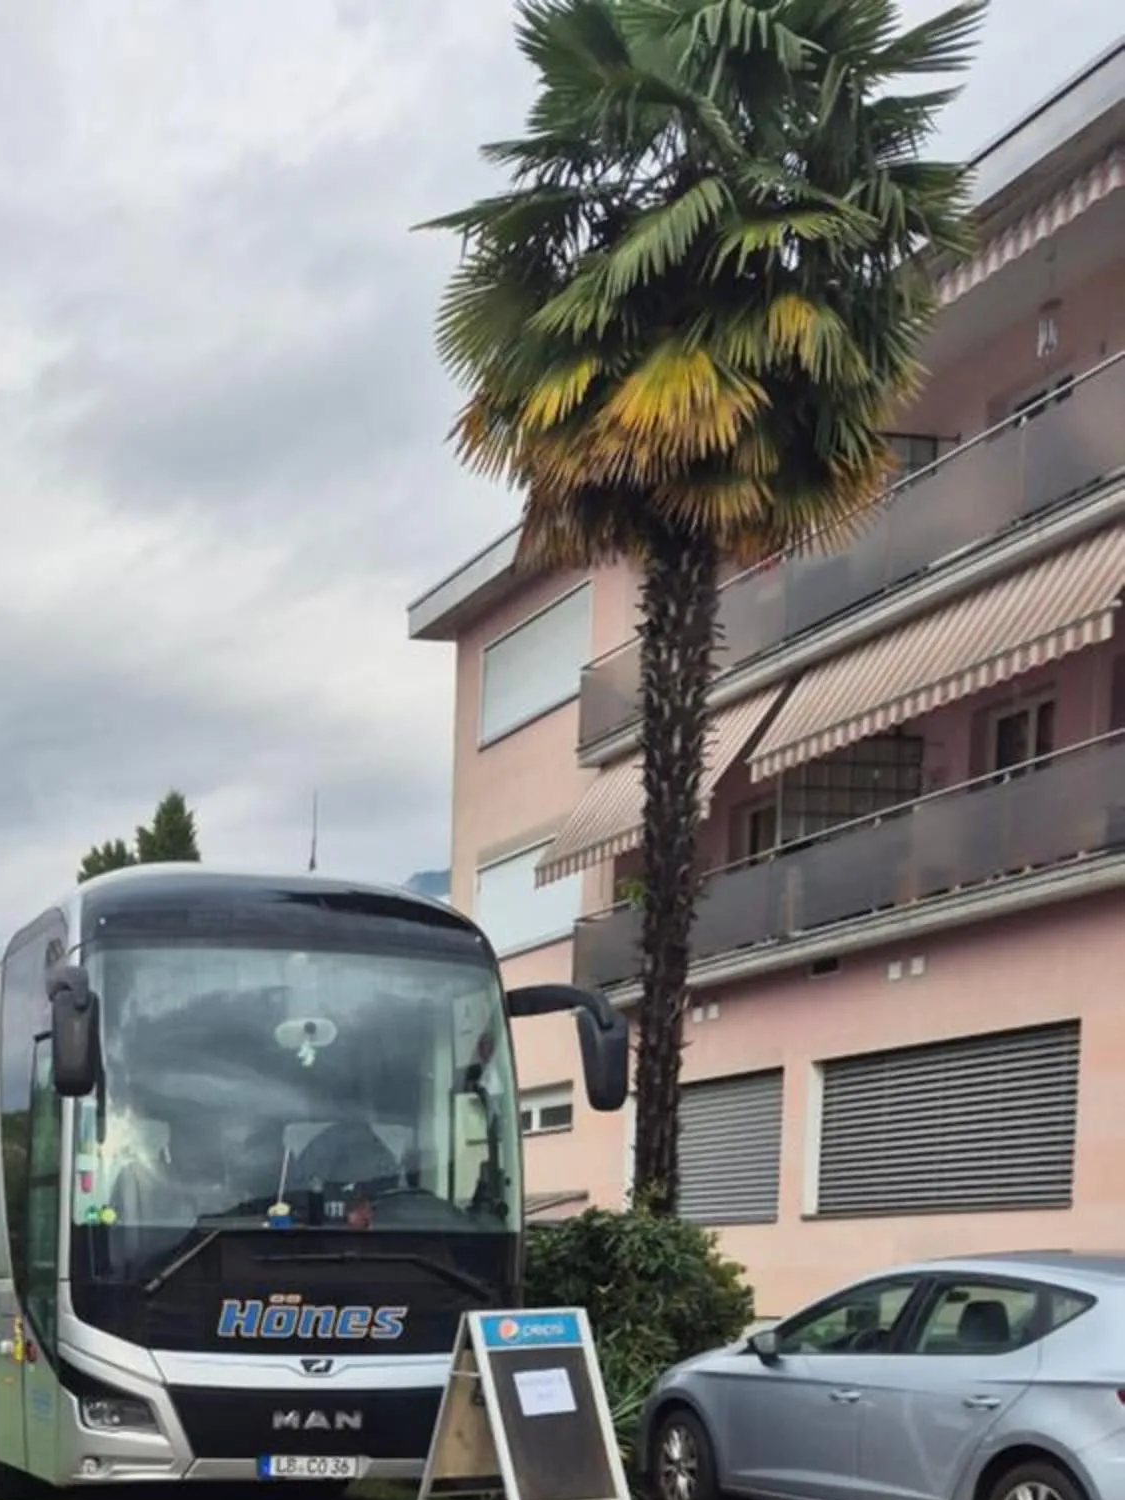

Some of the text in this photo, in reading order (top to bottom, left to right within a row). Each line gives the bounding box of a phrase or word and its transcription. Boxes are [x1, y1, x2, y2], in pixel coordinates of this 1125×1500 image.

[217, 1294, 408, 1339] Hönes
[522, 1321, 565, 1337] pepsi
[272, 1410, 362, 1430] MAN
